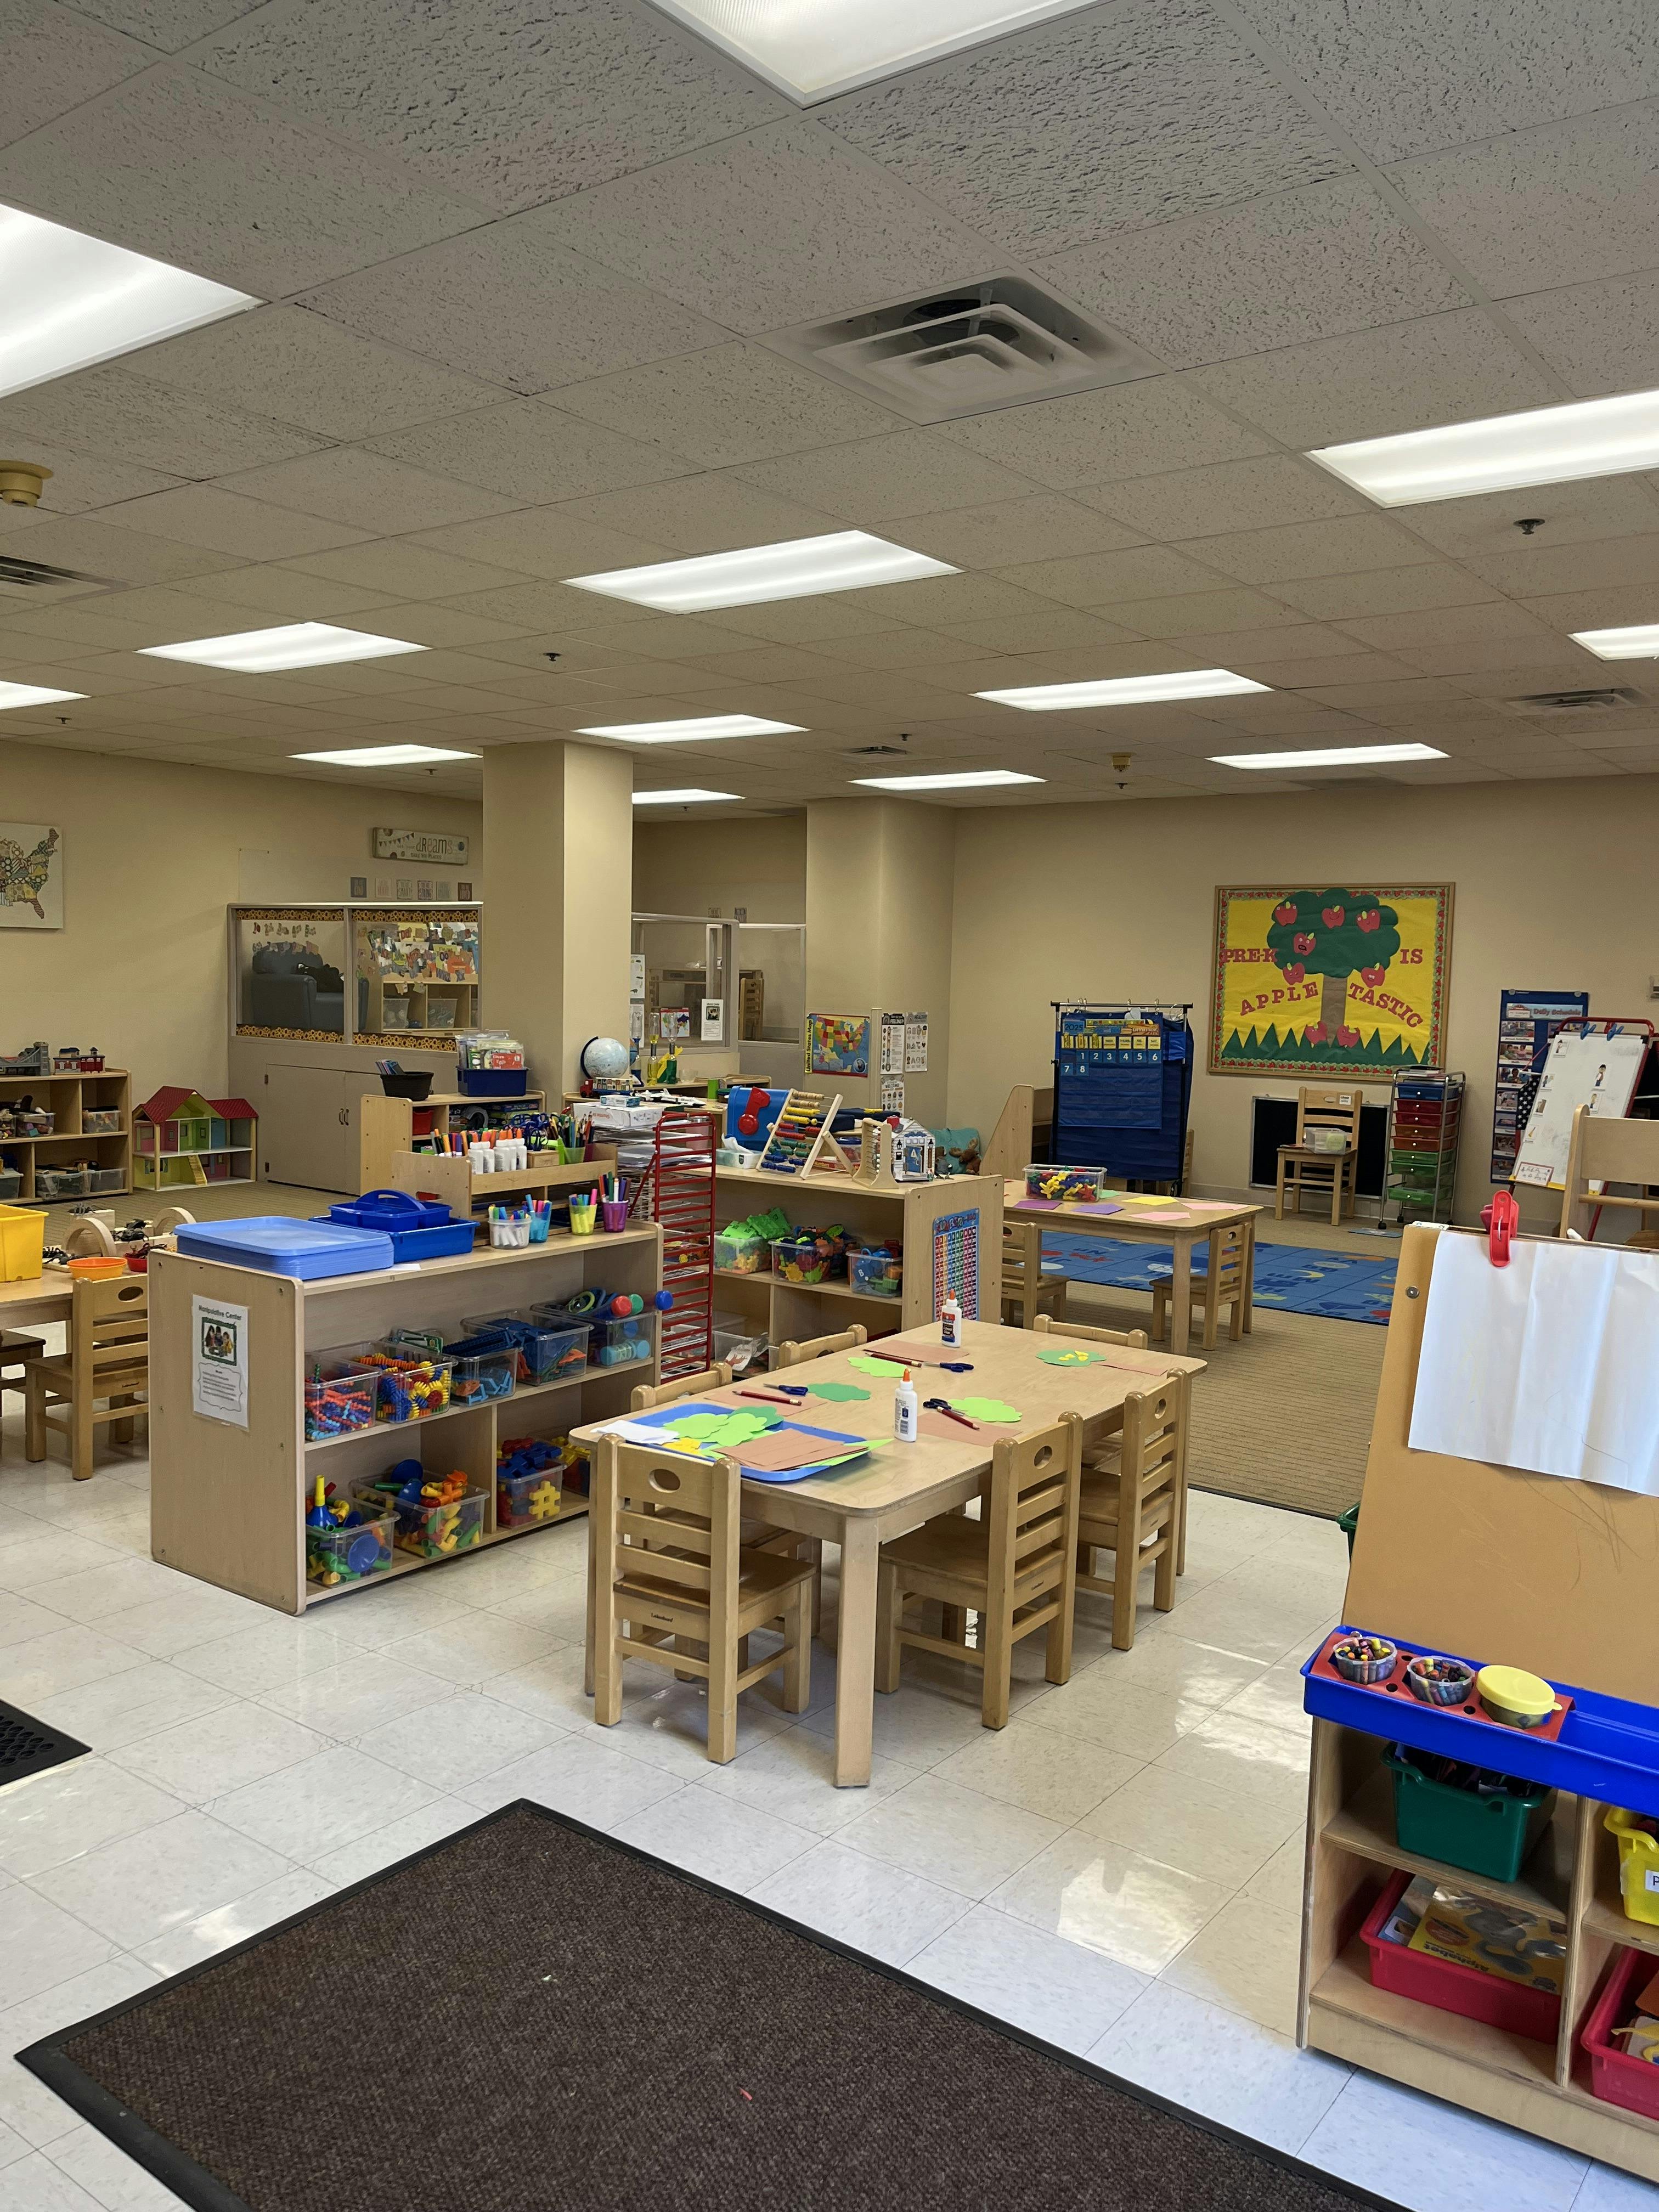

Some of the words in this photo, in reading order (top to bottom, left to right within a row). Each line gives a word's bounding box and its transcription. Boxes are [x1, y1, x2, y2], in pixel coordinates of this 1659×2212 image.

[1221, 948, 1278, 963] PRE-K
[1400, 949, 1423, 964] IS
[1240, 981, 1318, 1016] APPLE
[1347, 982, 1423, 1028] TASTIC
[858, 1269, 864, 1277] B
[199, 1305, 224, 1317] Manipulative
[225, 1312, 242, 1320] Center
